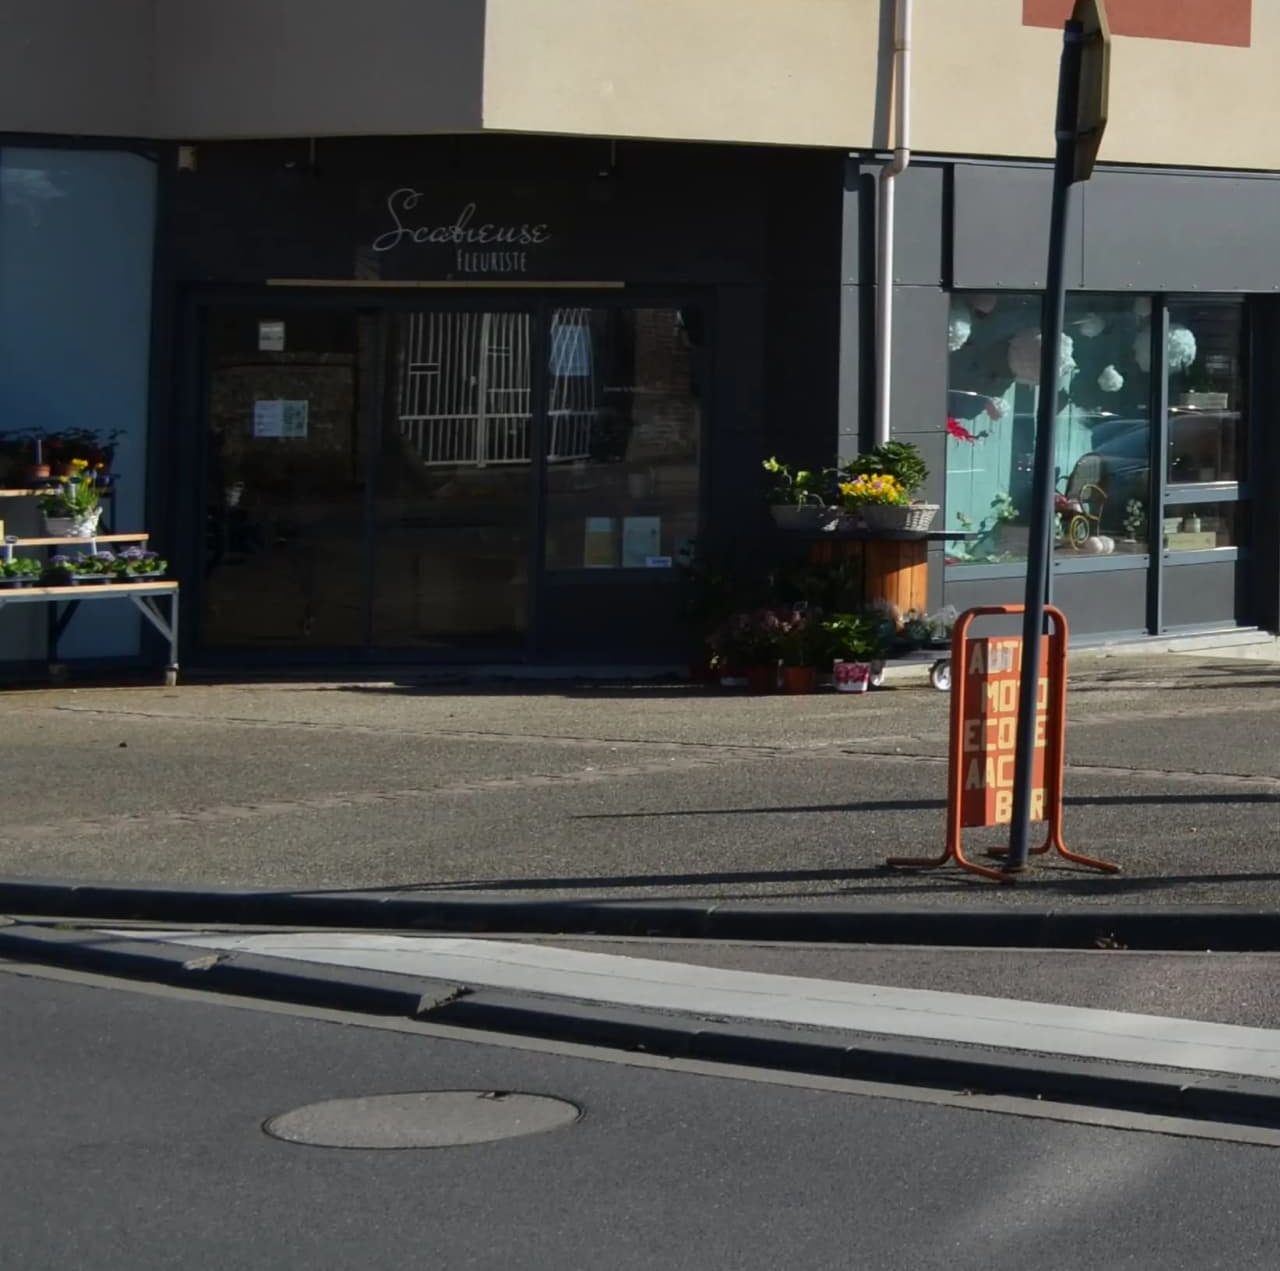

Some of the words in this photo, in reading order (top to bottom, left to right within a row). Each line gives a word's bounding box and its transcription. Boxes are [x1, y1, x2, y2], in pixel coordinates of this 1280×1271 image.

[372, 188, 551, 251] Scabieuse
[969, 640, 1023, 674] AUT
[982, 678, 1048, 713] MOO
[963, 715, 1048, 752] ECOE
[995, 788, 1046, 823] BR
